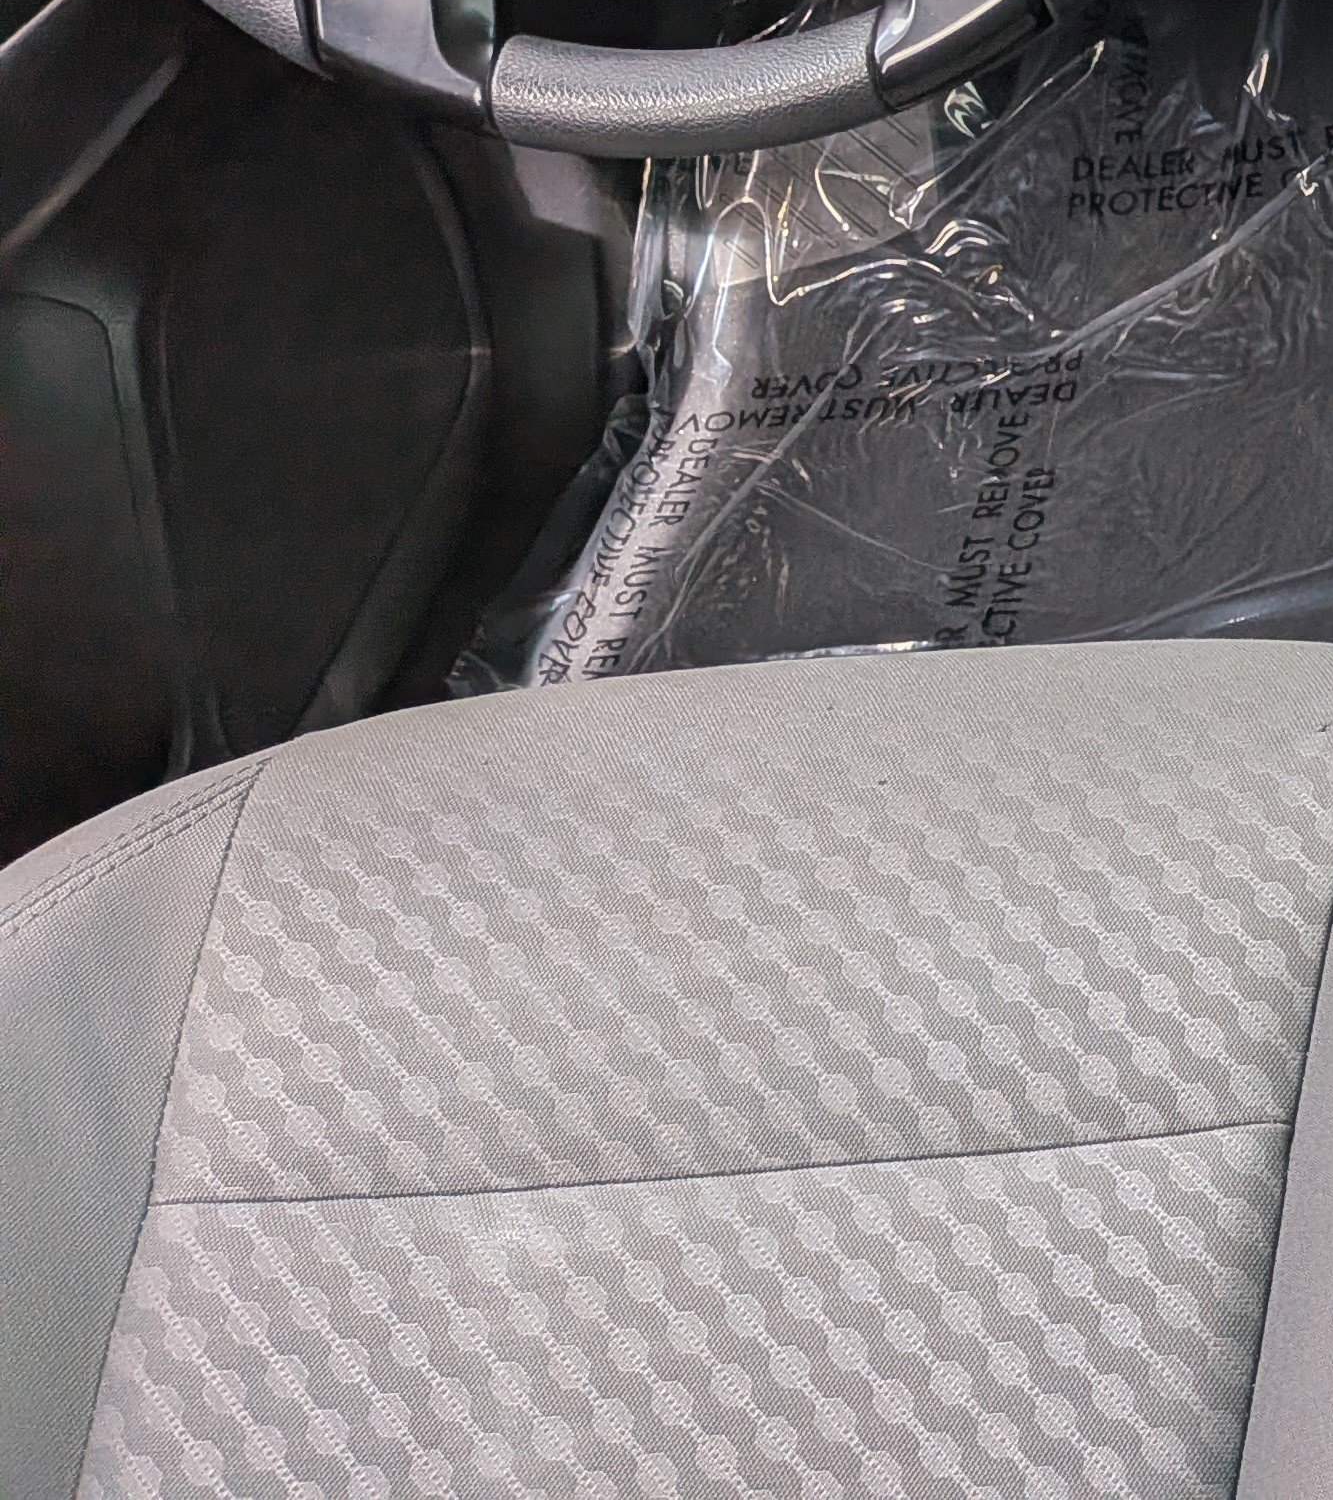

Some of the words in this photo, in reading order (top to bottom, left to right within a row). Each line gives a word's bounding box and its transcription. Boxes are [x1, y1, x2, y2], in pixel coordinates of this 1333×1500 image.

[1072, 149, 1196, 184] DEALER
[654, 438, 718, 528] DEALER
[608, 545, 662, 620] MUST
[946, 536, 991, 608] MUST
